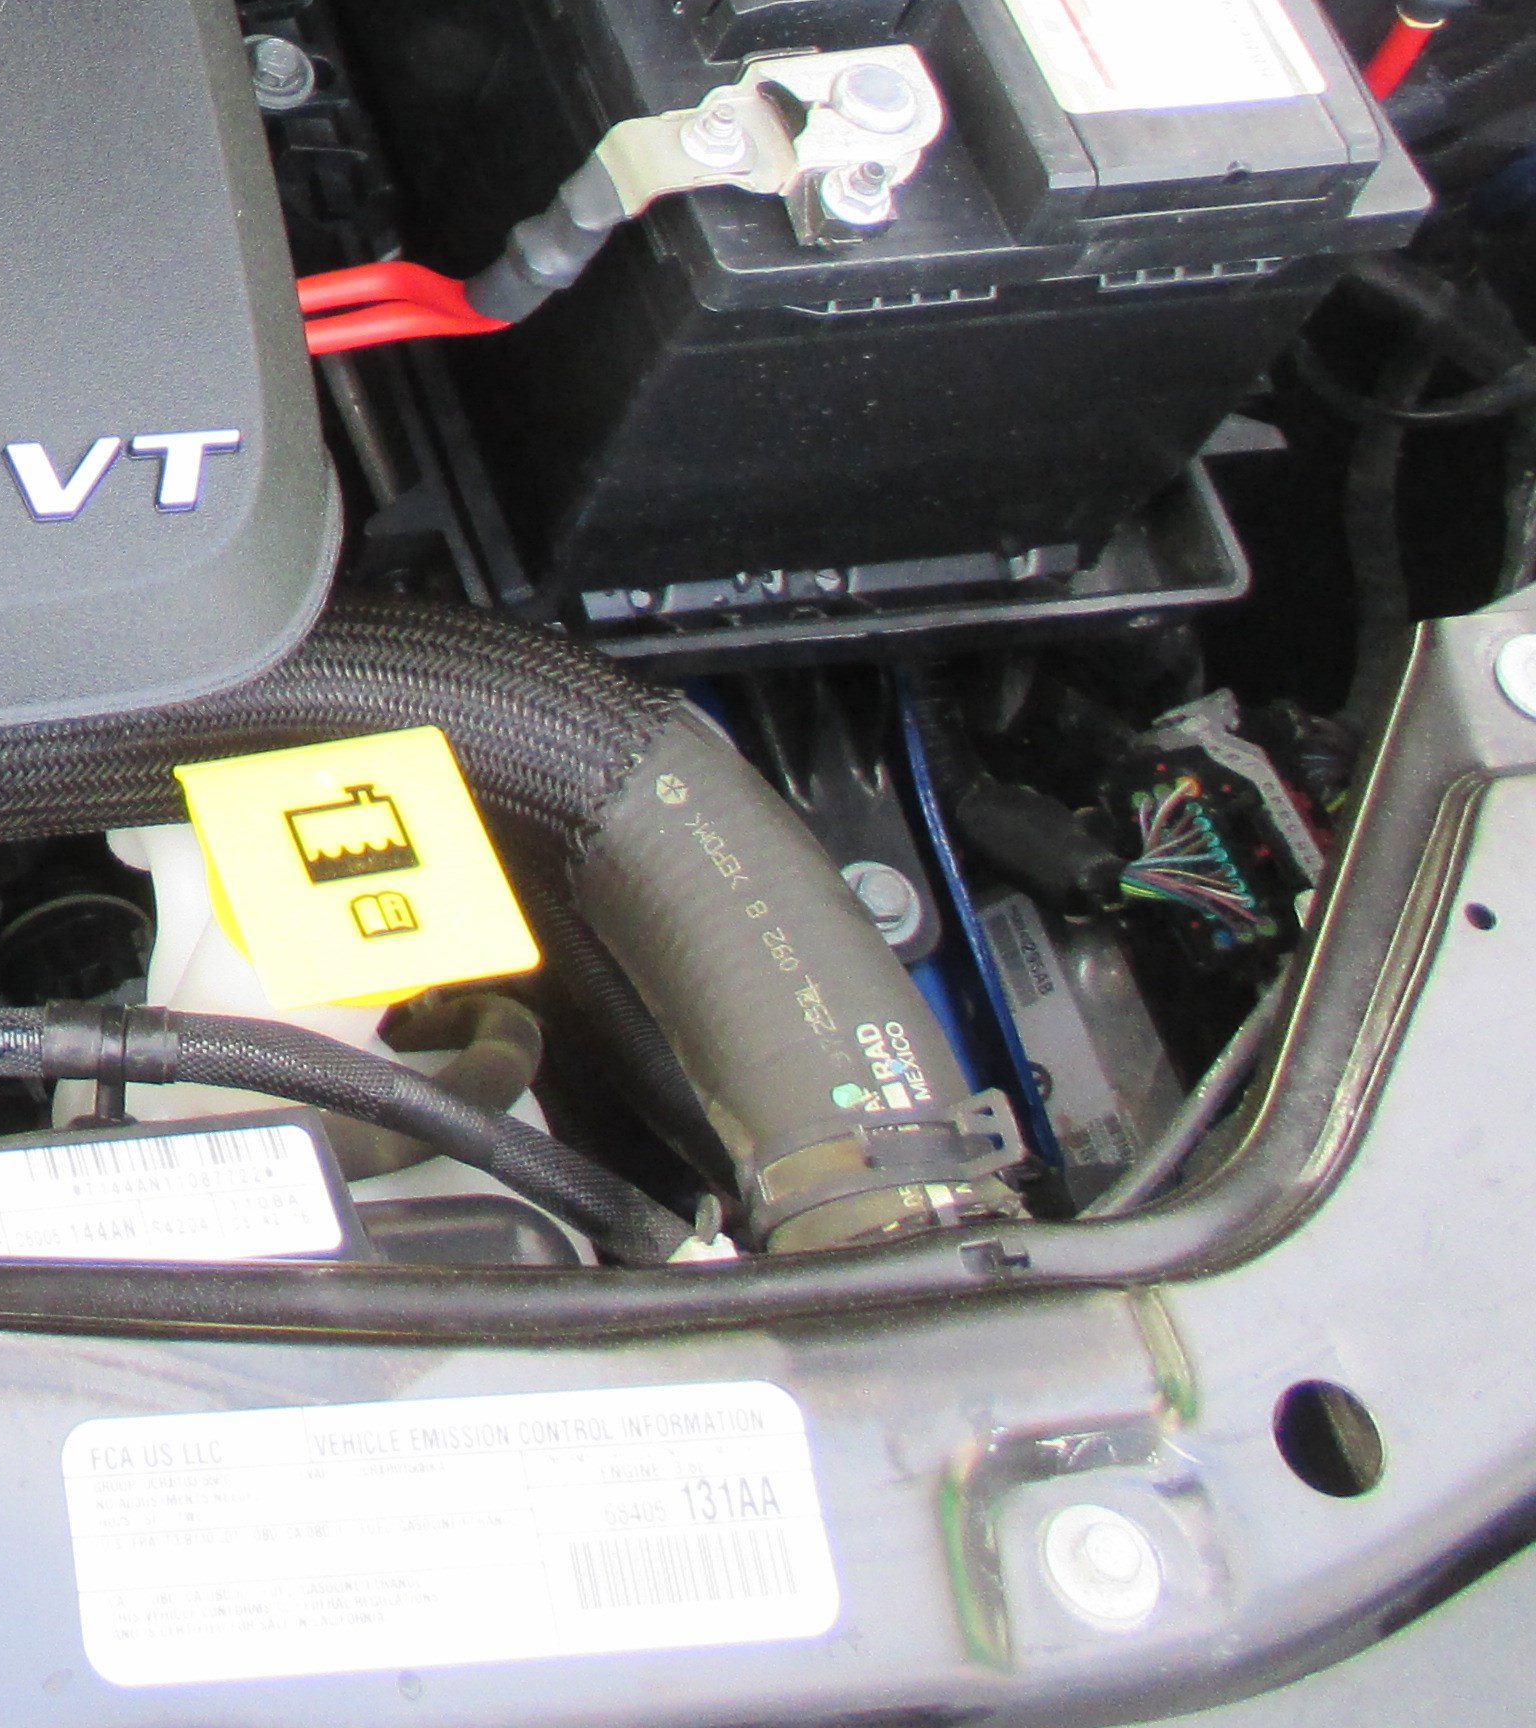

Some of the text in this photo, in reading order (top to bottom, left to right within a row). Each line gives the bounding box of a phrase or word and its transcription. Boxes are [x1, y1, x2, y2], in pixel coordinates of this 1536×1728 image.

[854, 1022, 900, 1082] RAD
[885, 1020, 933, 1103] MEXICO
[90, 1439, 223, 1470] FCA US LLC
[313, 1428, 401, 1457] VEHICLE
[408, 1423, 511, 1452] EMISSION
[519, 1417, 614, 1446] CONTROL
[621, 1408, 766, 1439] INFORMATION
[681, 1475, 781, 1522] 131AA
